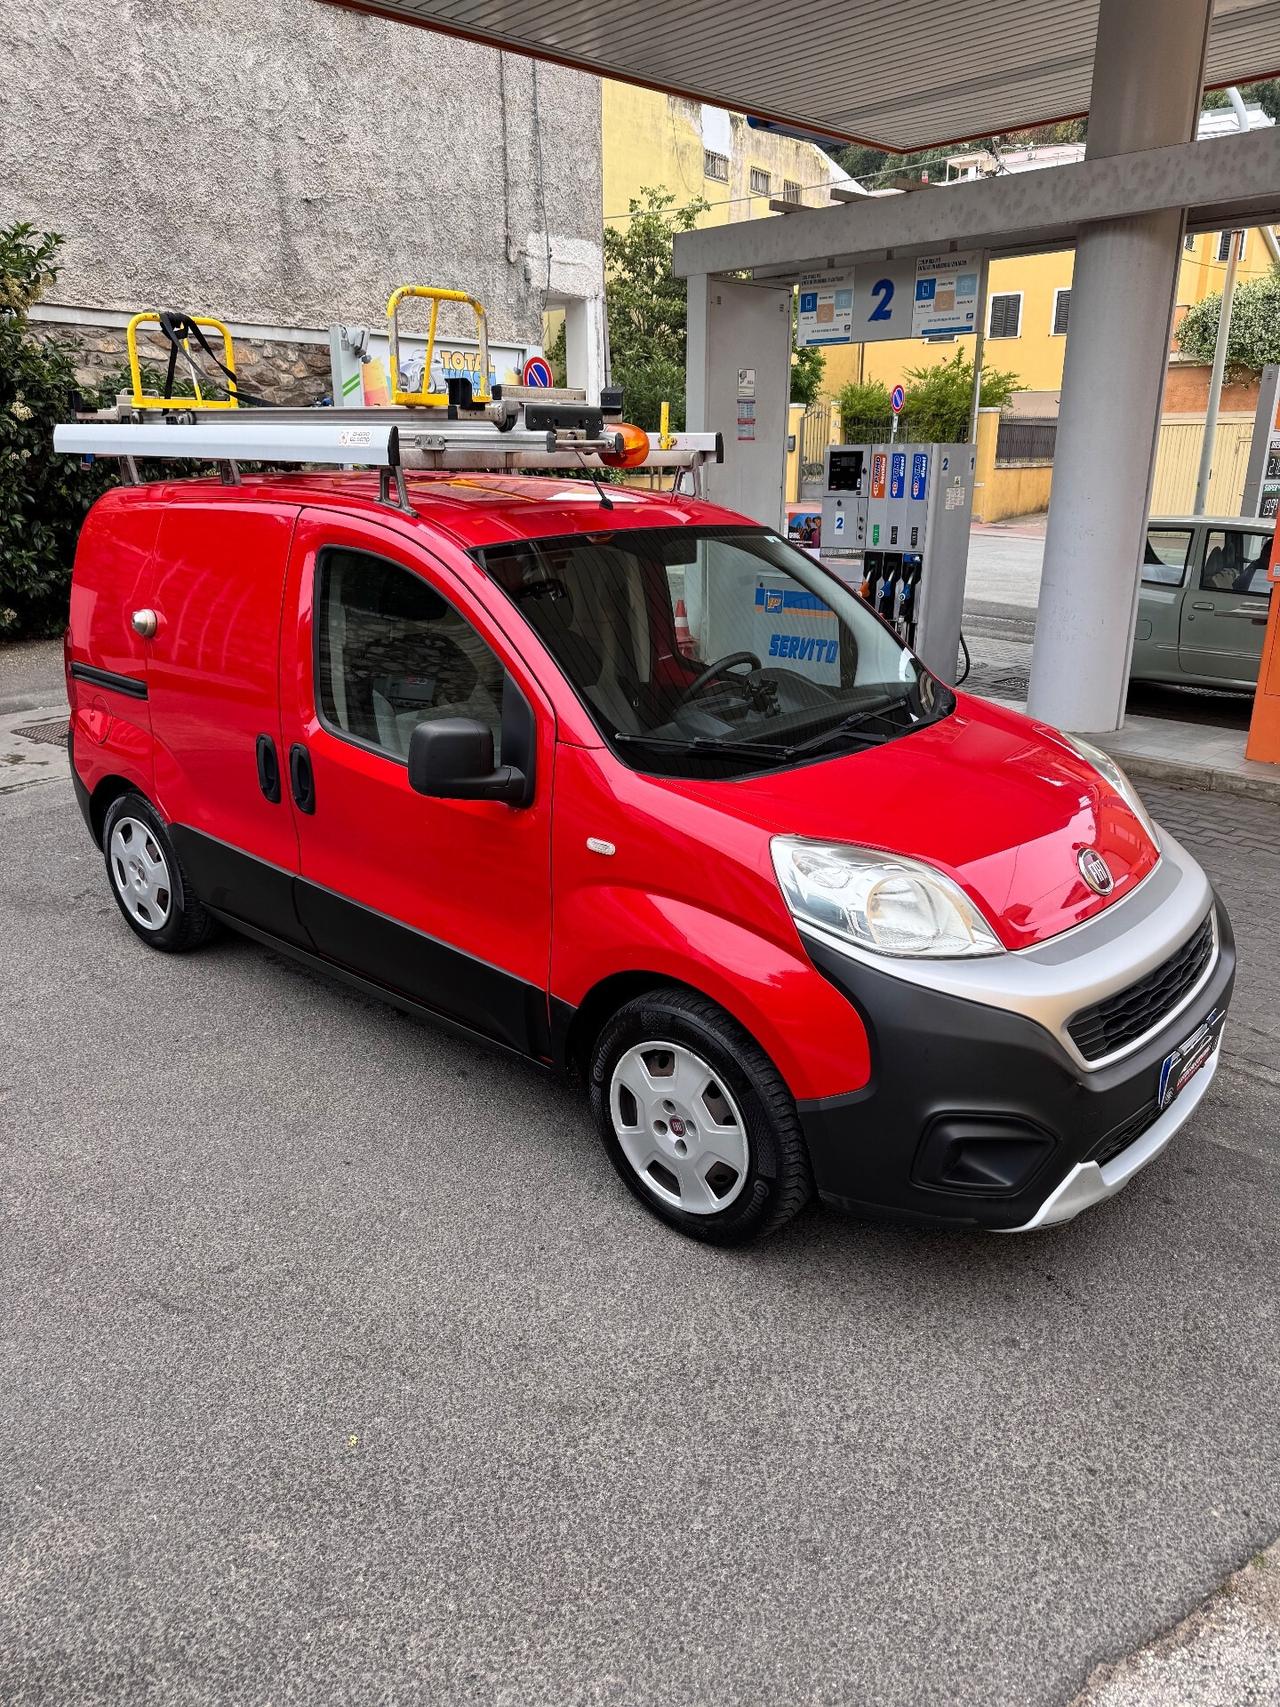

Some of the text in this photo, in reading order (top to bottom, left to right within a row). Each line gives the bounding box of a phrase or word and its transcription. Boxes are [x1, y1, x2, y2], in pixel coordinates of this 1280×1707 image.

[867, 278, 895, 323] 2
[942, 457, 949, 471] 2
[970, 457, 975, 470] 1
[836, 517, 844, 529] 2
[768, 633, 840, 664] SERVITO
[1088, 859, 1108, 884] FIAT
